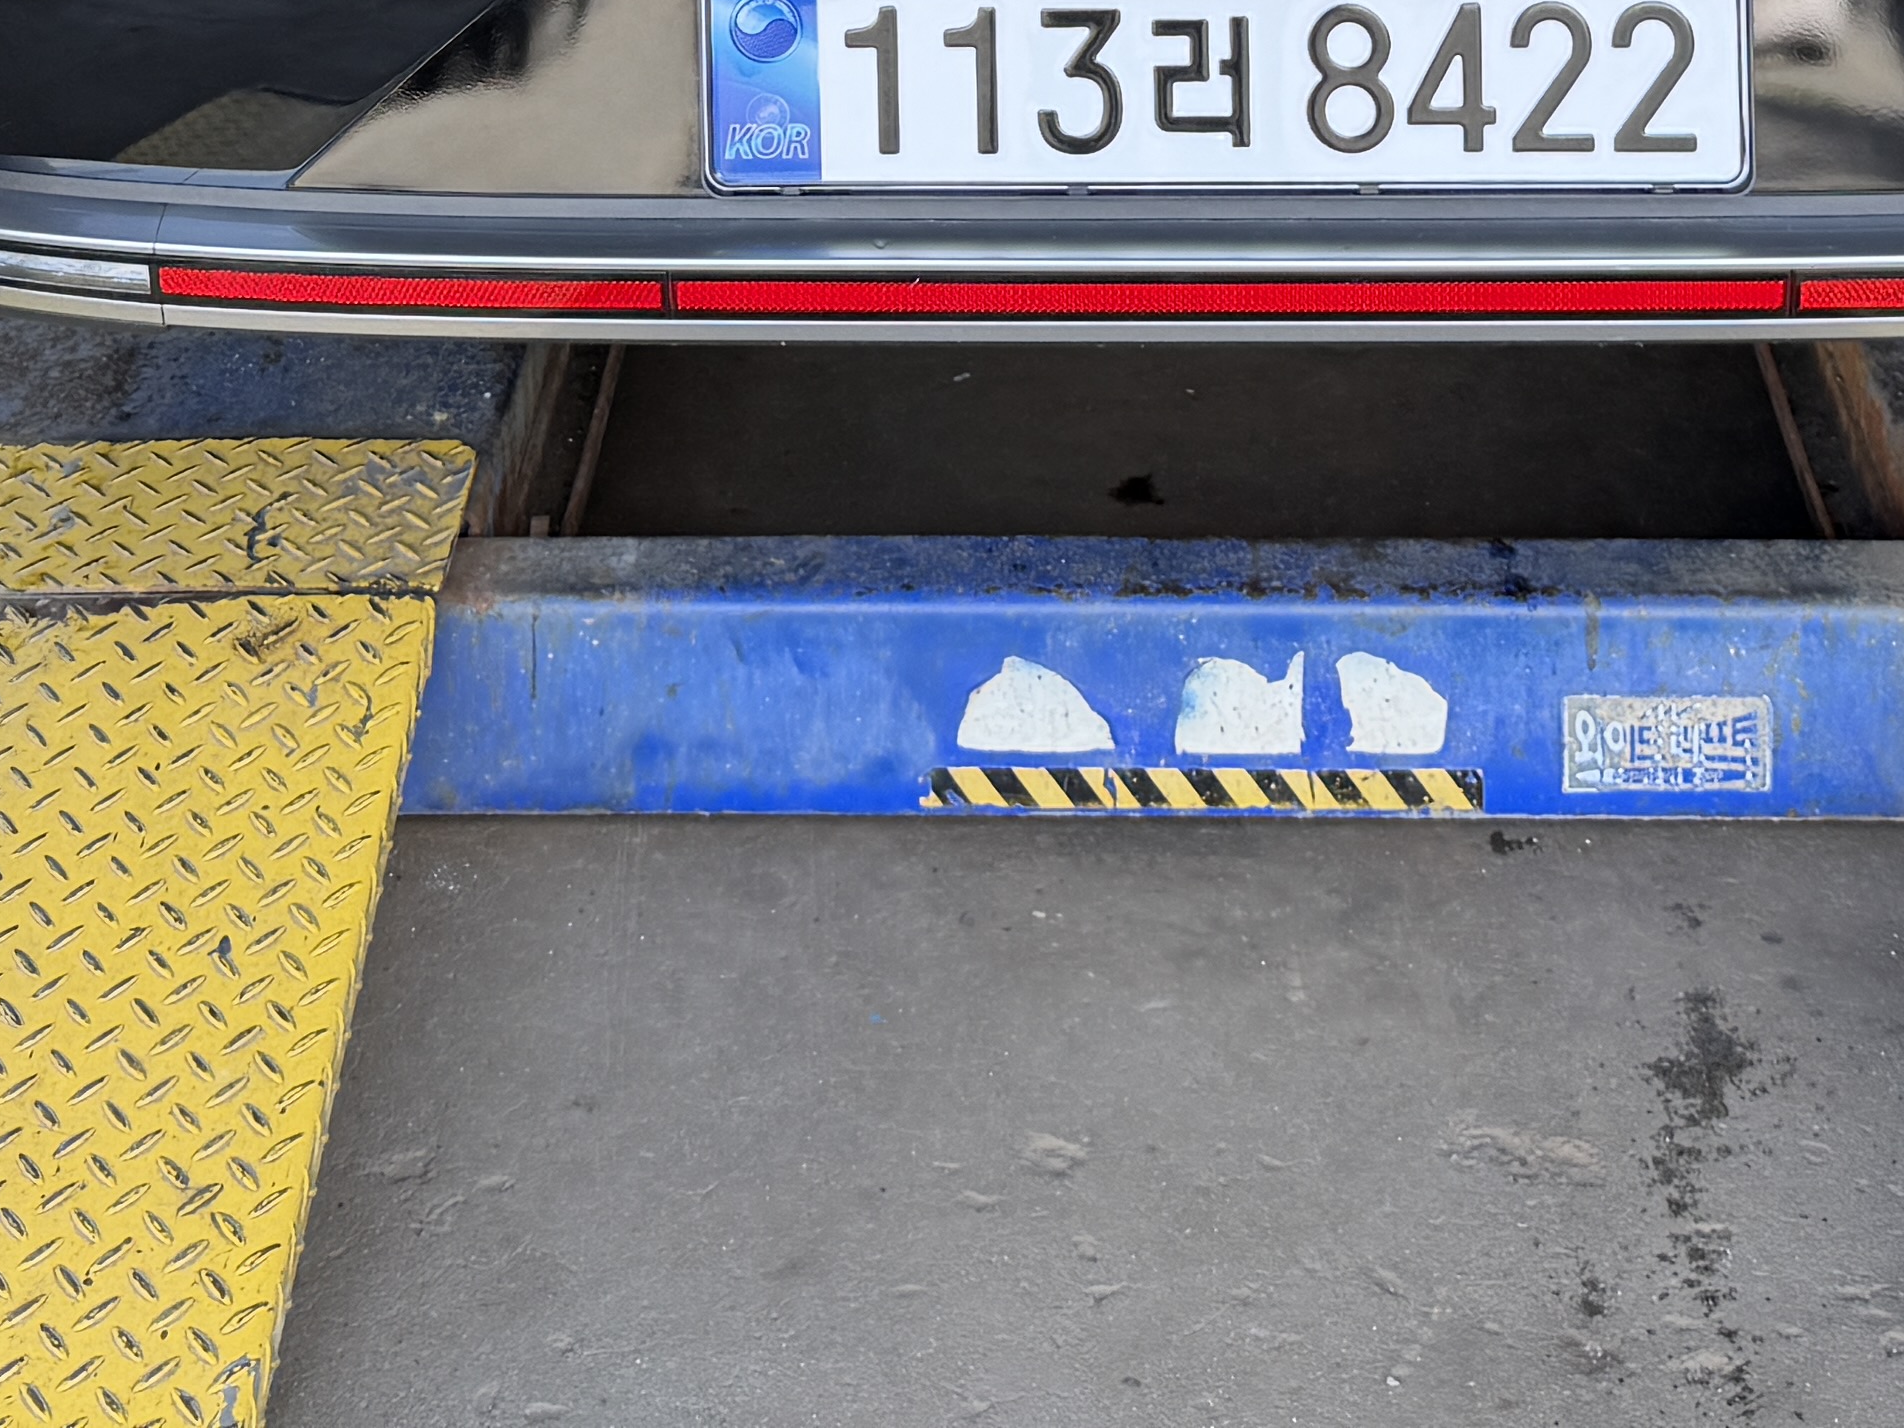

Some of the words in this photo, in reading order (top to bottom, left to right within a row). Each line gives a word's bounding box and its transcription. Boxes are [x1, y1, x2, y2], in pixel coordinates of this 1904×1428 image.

[843, 4, 1250, 156] 113러
[1305, 0, 1698, 154] 8422
[724, 123, 811, 160] KOR
